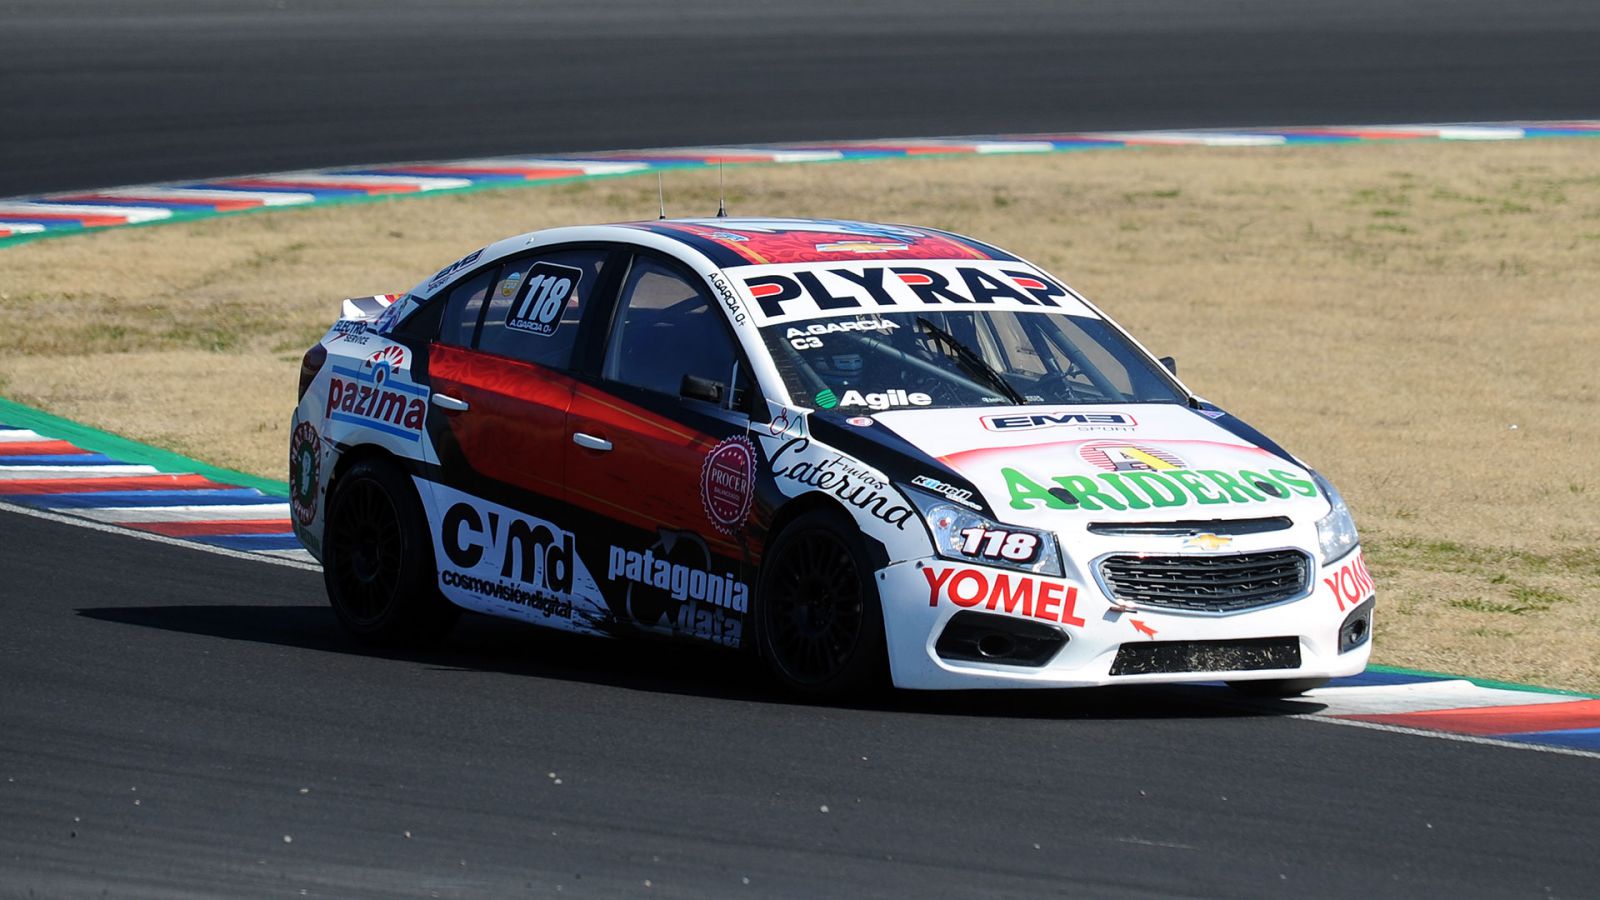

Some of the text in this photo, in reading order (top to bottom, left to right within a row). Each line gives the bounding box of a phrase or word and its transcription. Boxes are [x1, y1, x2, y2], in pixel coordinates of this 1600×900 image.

[517, 274, 571, 323] 118
[744, 267, 1067, 318] PLYRAP
[333, 320, 367, 335] ELECTRO
[344, 333, 370, 345] SERVICE
[787, 320, 900, 338] A.GARCIA
[791, 337, 823, 350] C3
[326, 377, 427, 430] pazima
[840, 389, 932, 410] Agile
[711, 467, 747, 494] PROCER
[770, 437, 914, 531] Caterina
[828, 451, 888, 490] Frutas
[961, 527, 1038, 562] 118
[608, 544, 749, 614] patagonia
[922, 567, 1086, 628] YOMEL
